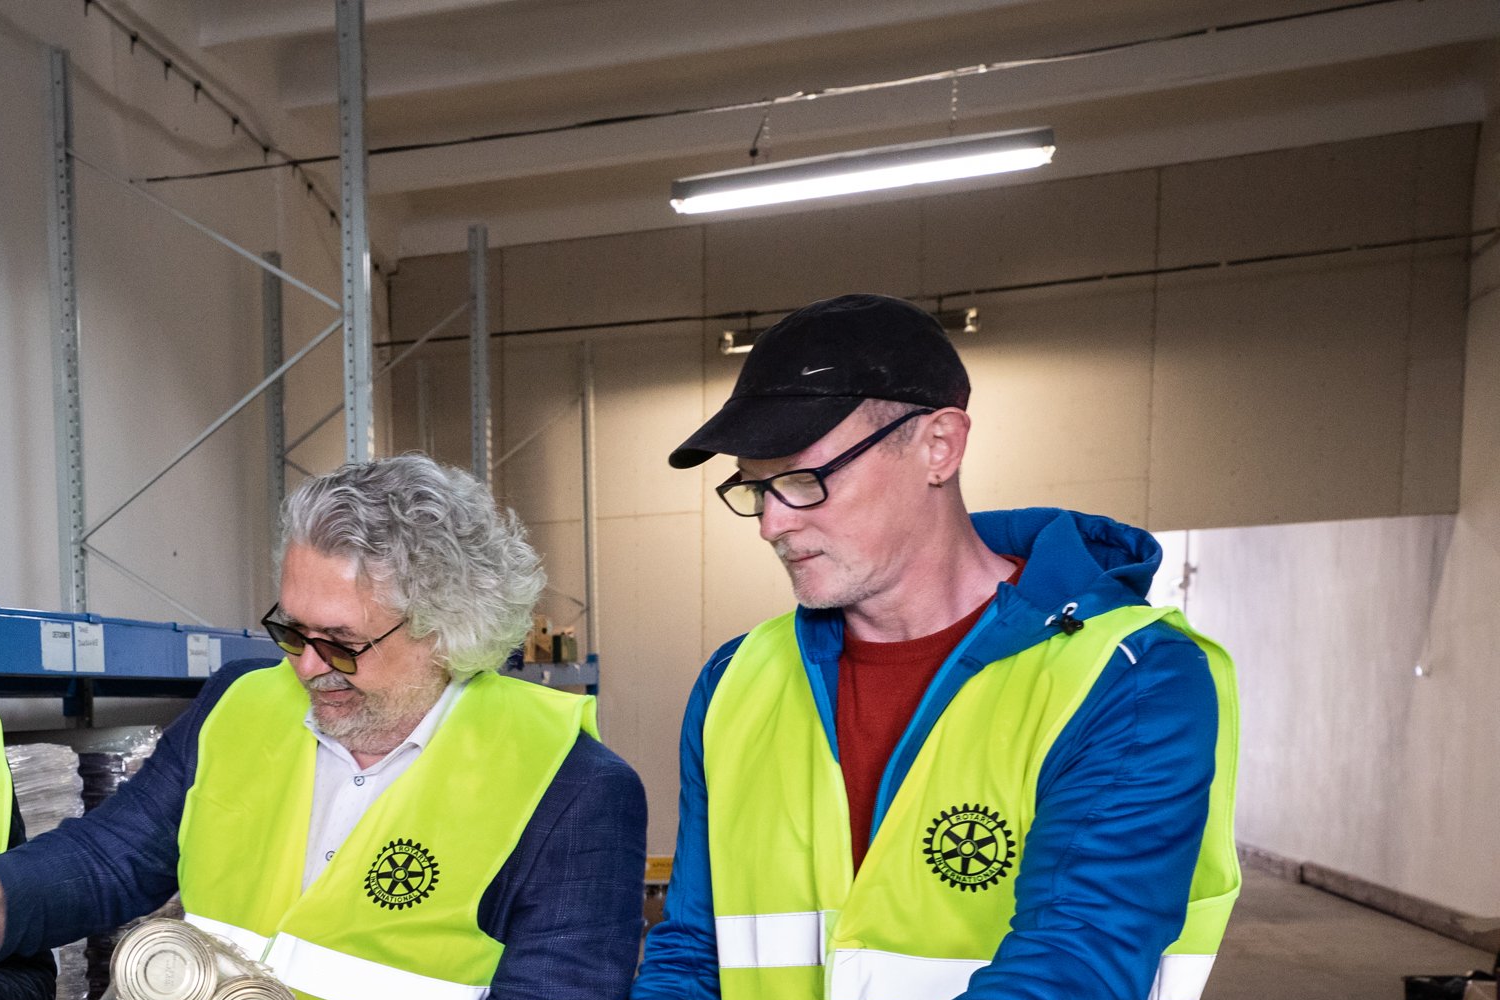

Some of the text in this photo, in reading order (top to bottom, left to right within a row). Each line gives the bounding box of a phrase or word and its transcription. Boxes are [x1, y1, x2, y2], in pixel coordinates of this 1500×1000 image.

[955, 814, 992, 826] ROTARY
[398, 846, 428, 863] ROTARY
[935, 856, 1000, 883] INTERNATIONAL
[371, 876, 418, 903] INTERNATIONAL
